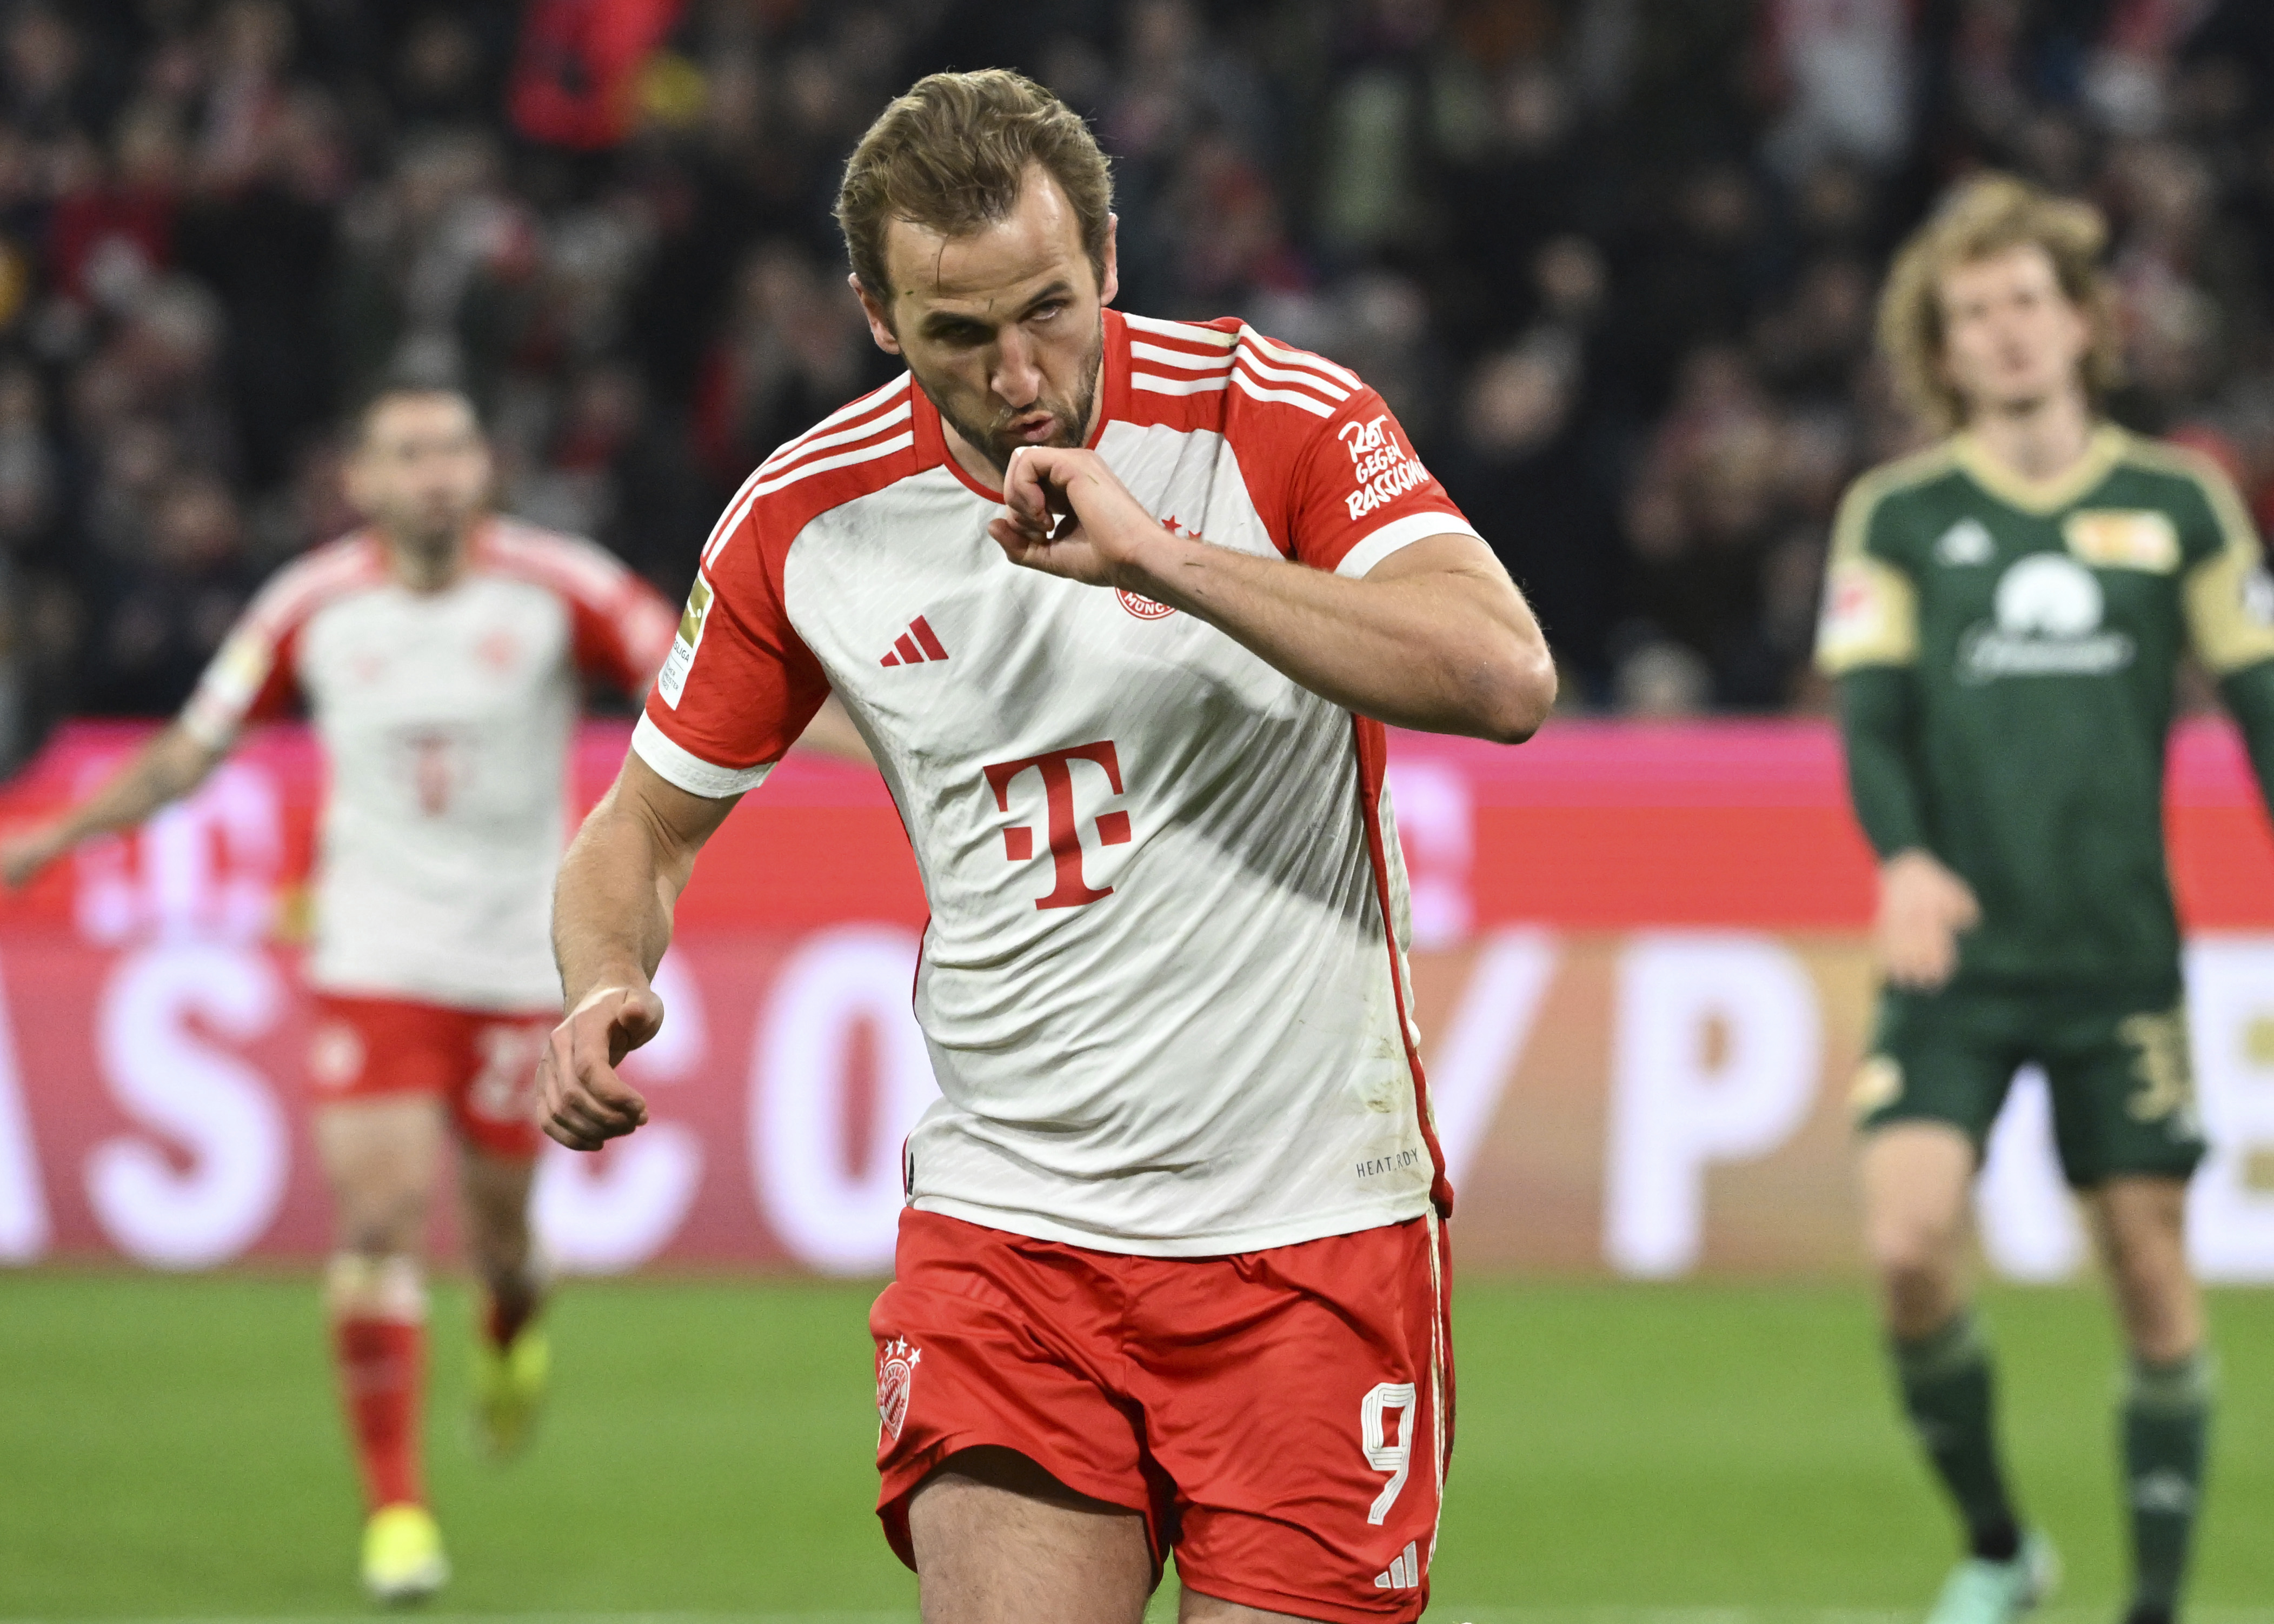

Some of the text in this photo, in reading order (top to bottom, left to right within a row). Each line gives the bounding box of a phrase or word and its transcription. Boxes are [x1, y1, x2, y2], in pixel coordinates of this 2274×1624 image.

[1338, 415, 1389, 463] ROT
[1355, 431, 1406, 484] GEGEN
[1345, 454, 1429, 521] RASSISMU
[1124, 592, 1167, 614] MÜNC
[982, 740, 1132, 910] T
[1356, 1148, 1419, 1178] HEAT.RDY
[1360, 1382, 1417, 1526] 9
